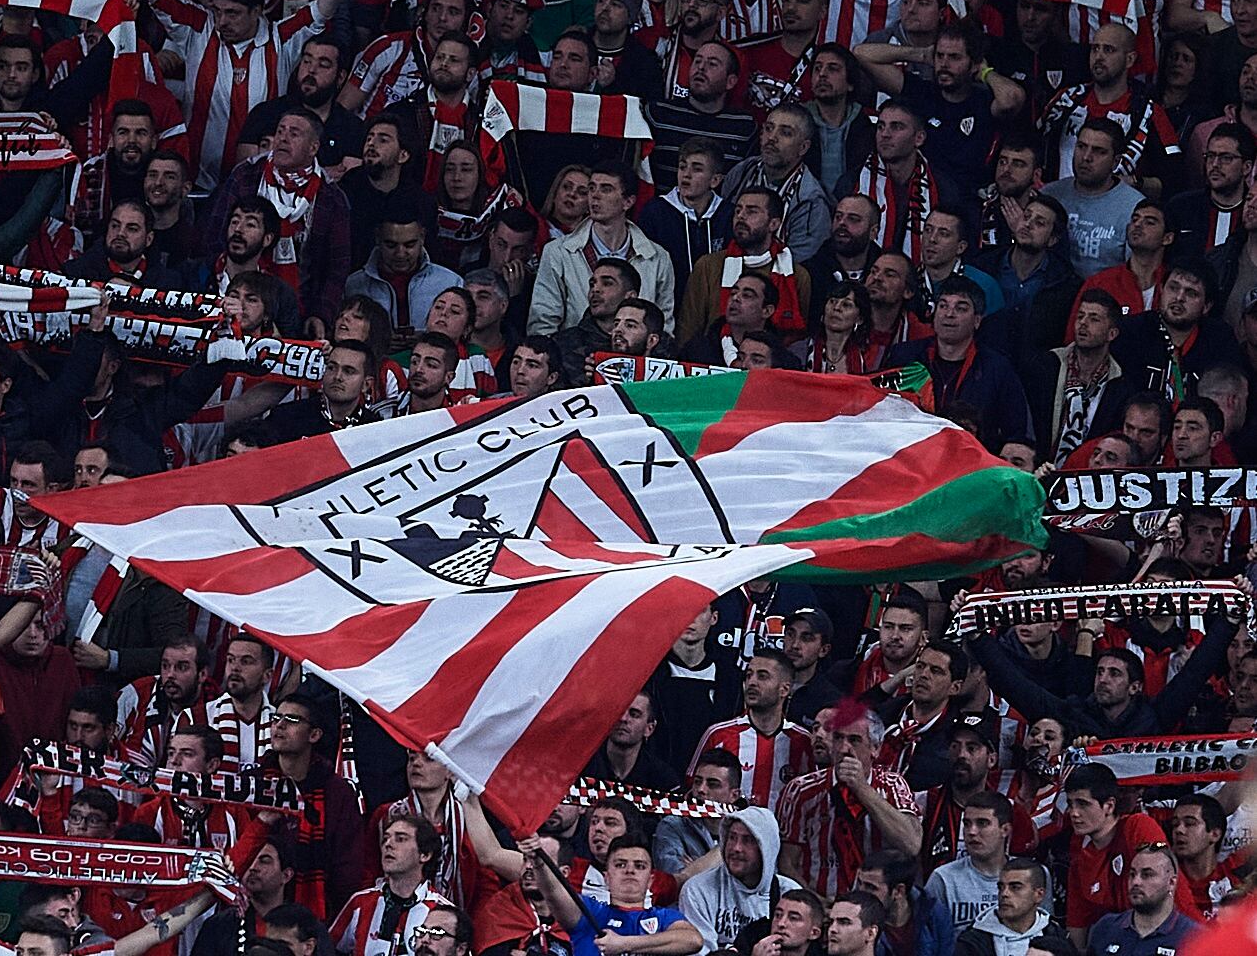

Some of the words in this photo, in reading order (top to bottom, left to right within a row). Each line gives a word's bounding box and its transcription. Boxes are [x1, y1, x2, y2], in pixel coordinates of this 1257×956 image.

[284, 343, 325, 381] 98
[476, 393, 602, 452] CLUB
[1155, 753, 1248, 776] BILBAO
[29, 847, 92, 866] f-09
[96, 852, 164, 867] copa
